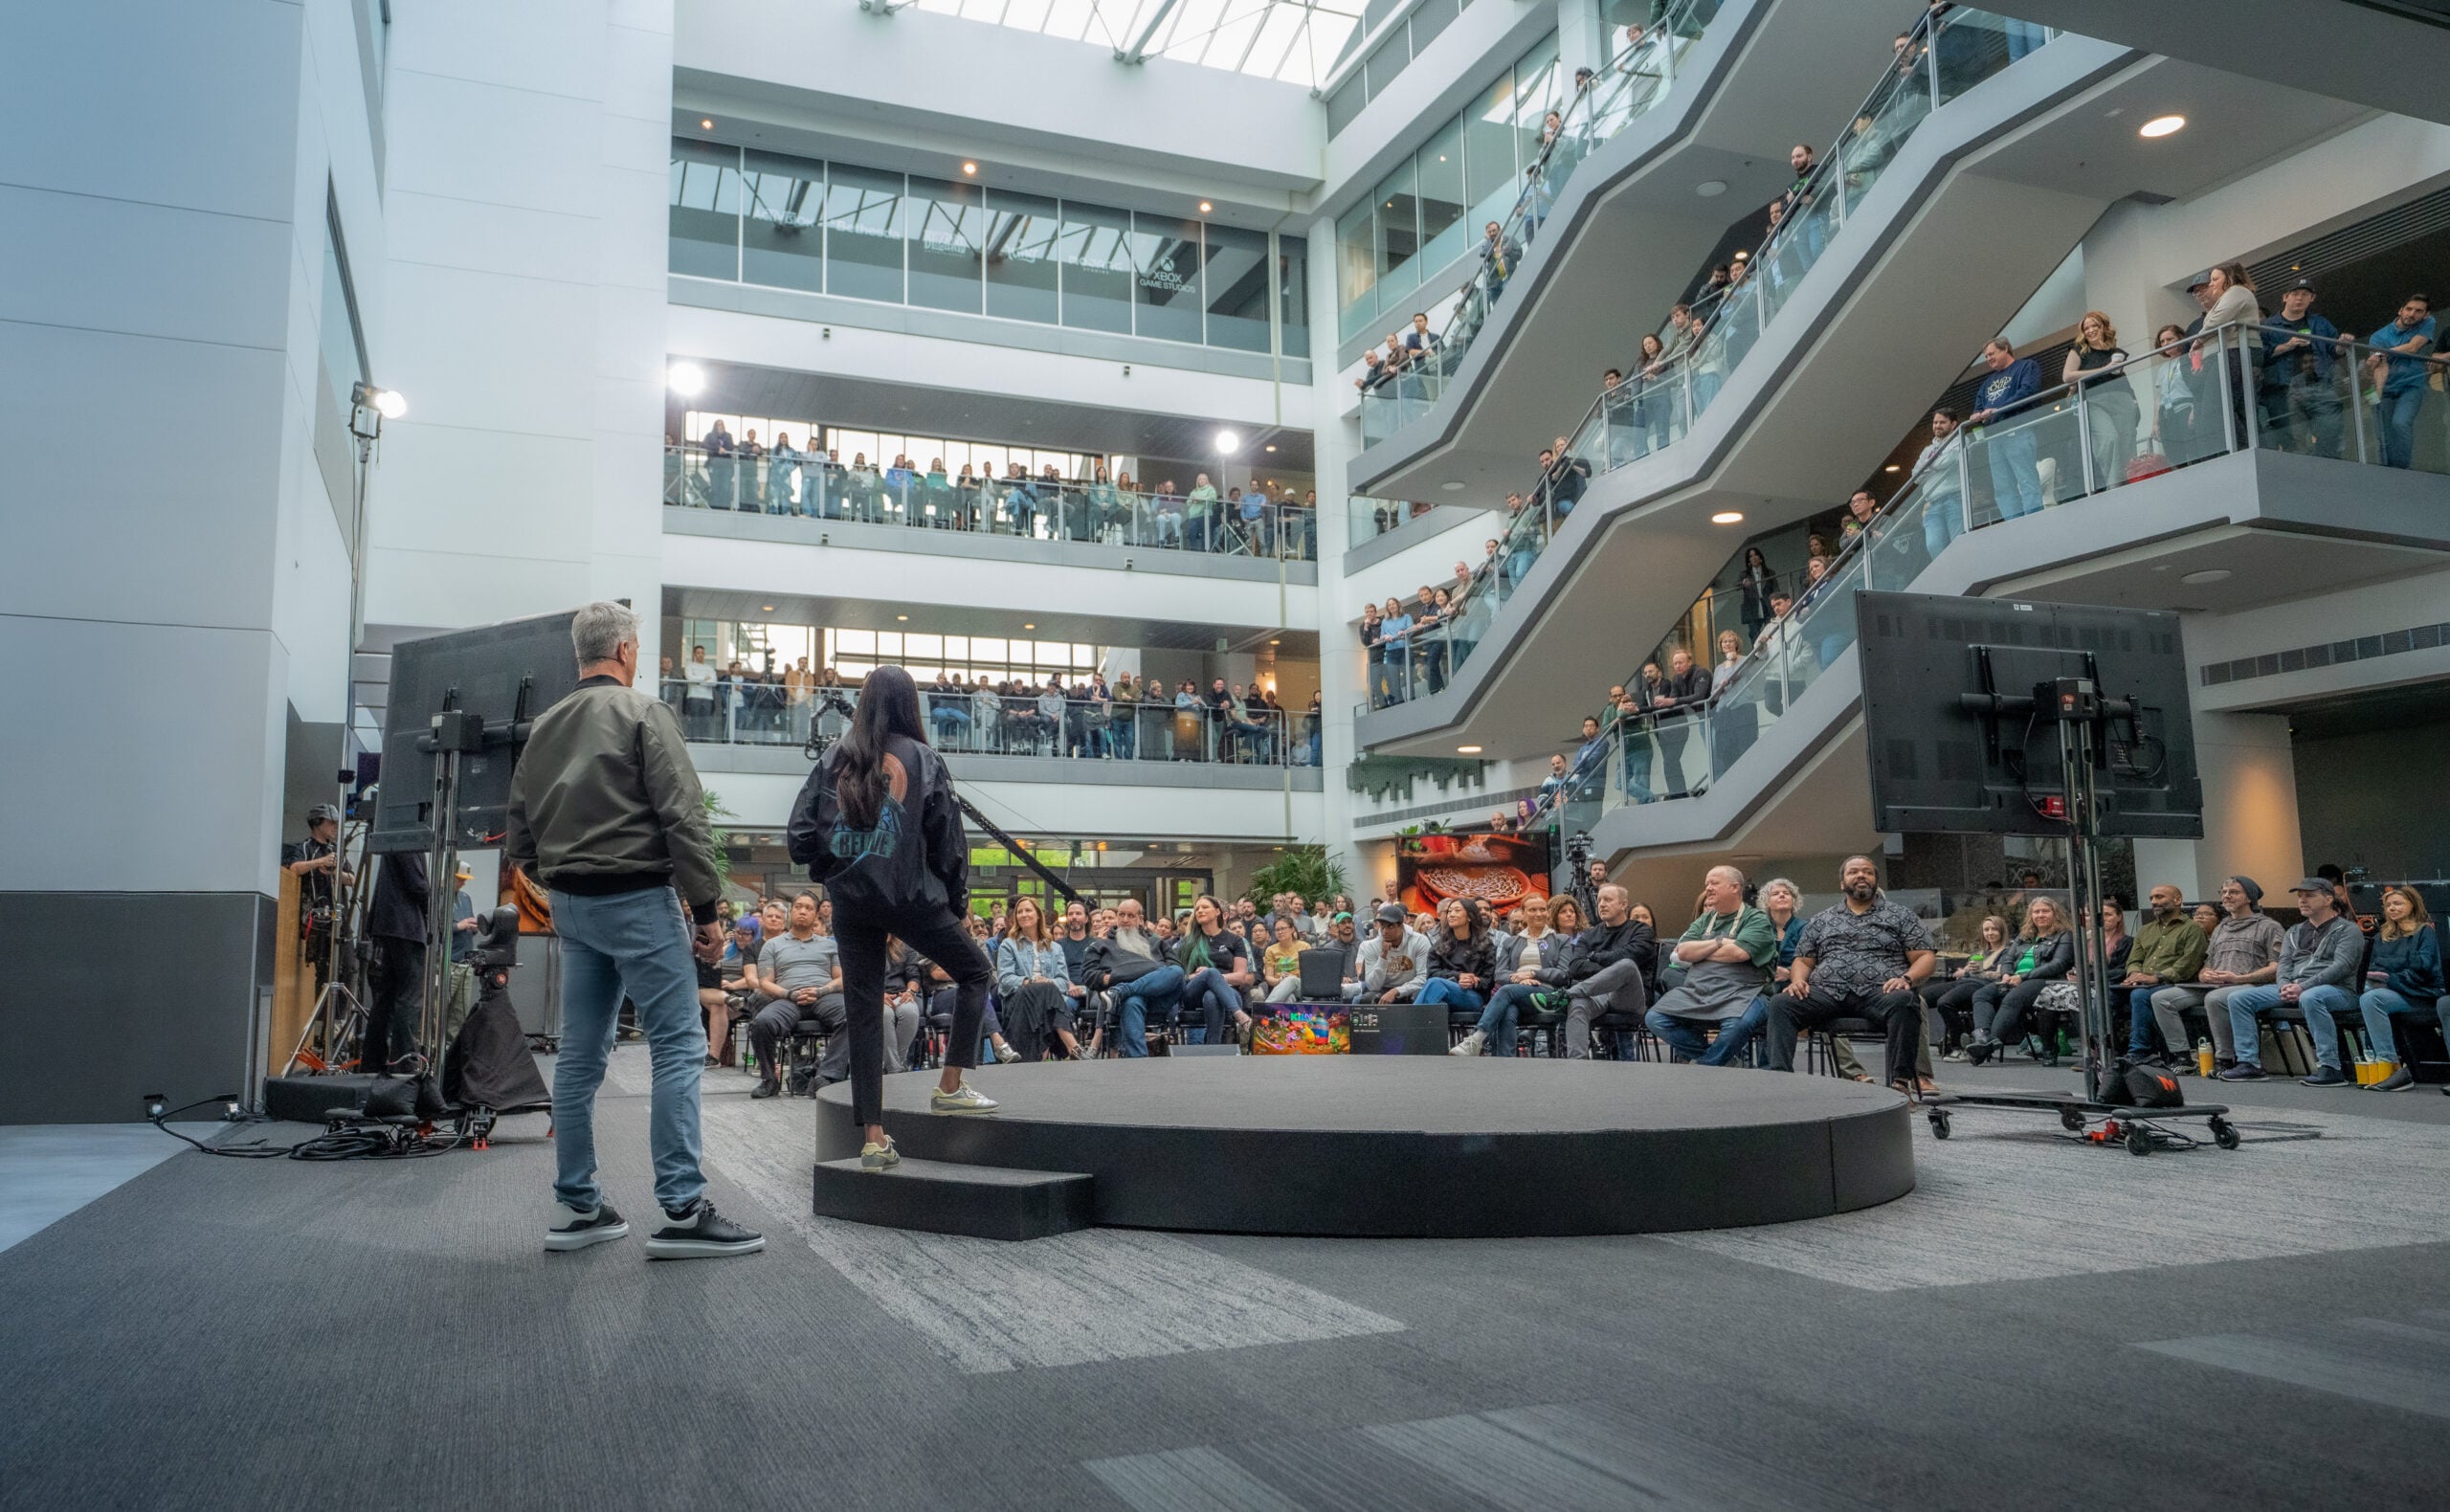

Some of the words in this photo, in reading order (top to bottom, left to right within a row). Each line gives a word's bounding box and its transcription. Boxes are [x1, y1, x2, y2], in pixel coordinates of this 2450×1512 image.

[1152, 270, 1183, 284] XBOX
[1139, 278, 1163, 289] GAME
[1163, 281, 1195, 293] STUDIOS
